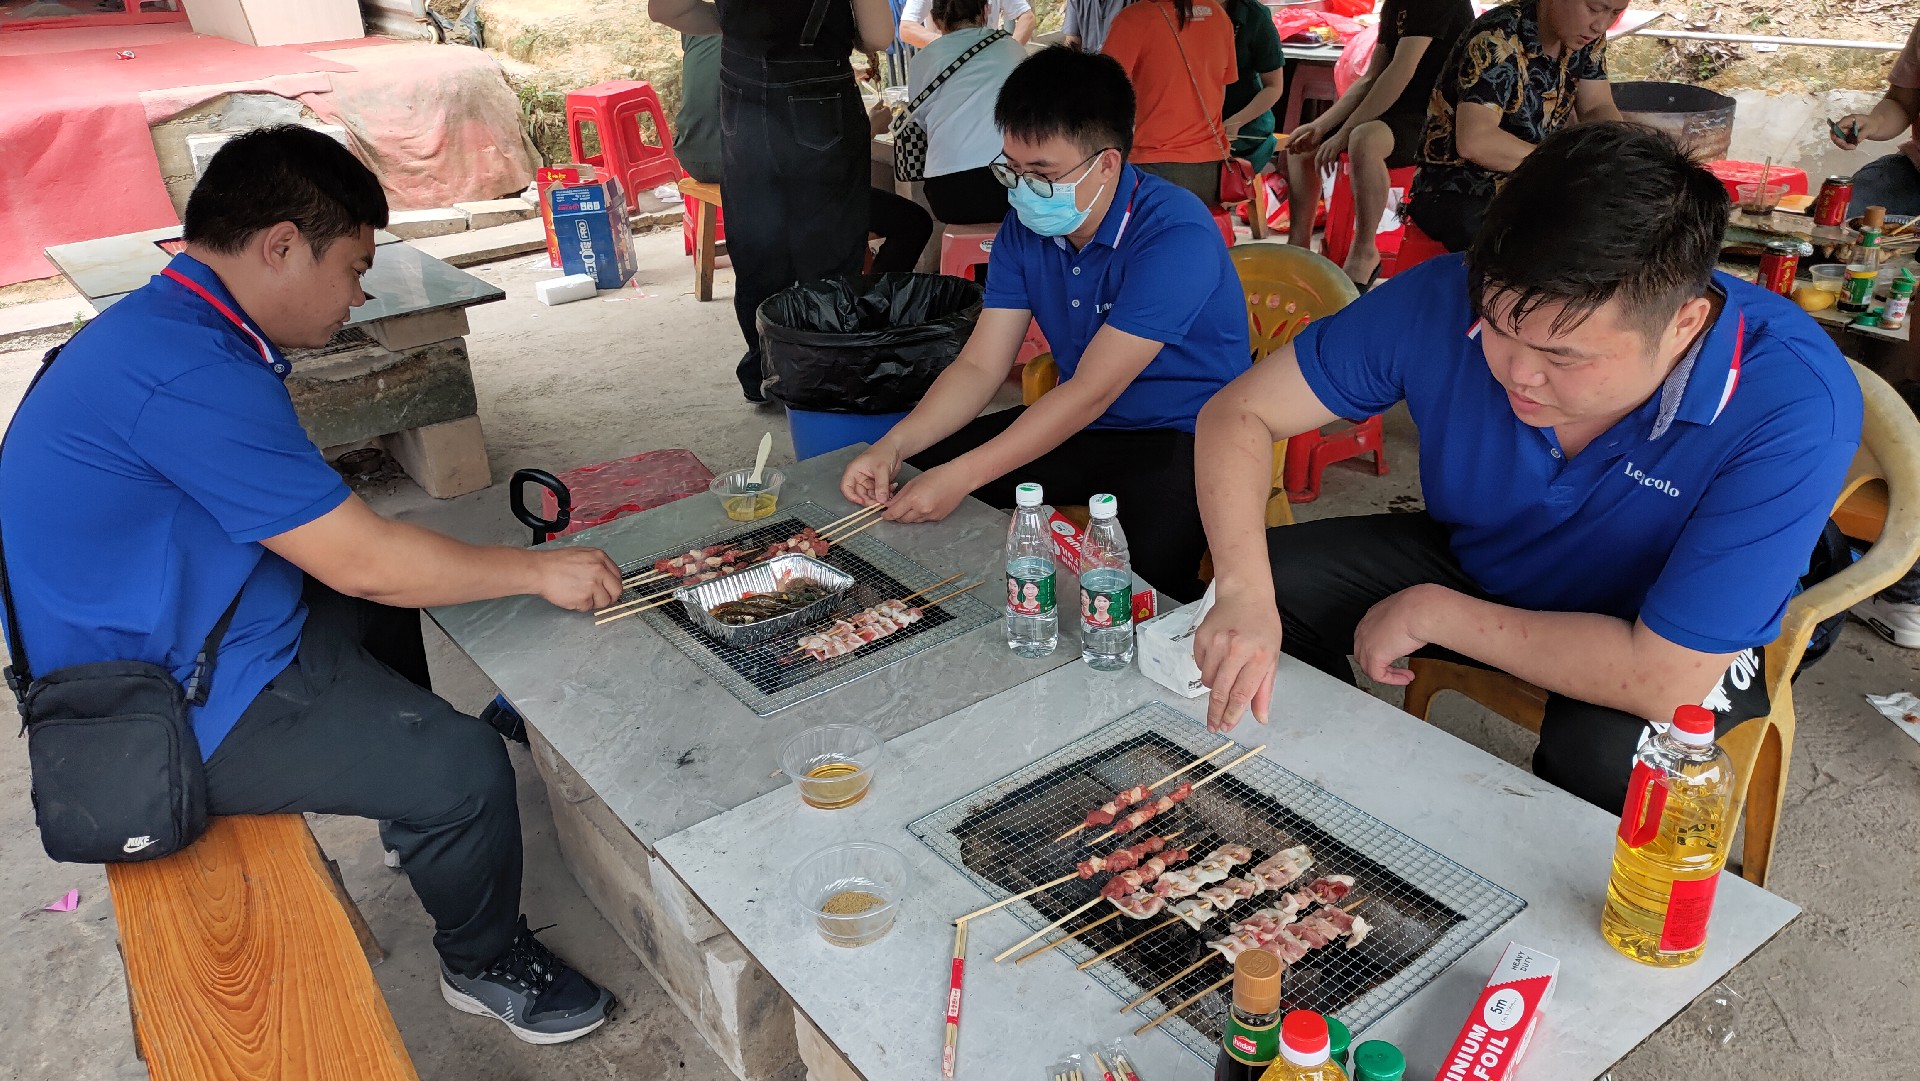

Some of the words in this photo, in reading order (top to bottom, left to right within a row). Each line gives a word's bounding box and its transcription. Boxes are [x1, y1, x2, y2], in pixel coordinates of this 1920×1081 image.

[127, 835, 151, 847] NIKE
[1511, 951, 1526, 971] HEAVY
[1520, 956, 1534, 972] DUTY
[1490, 999, 1508, 1015] 5m
[1473, 1035, 1509, 1081] FOIL
